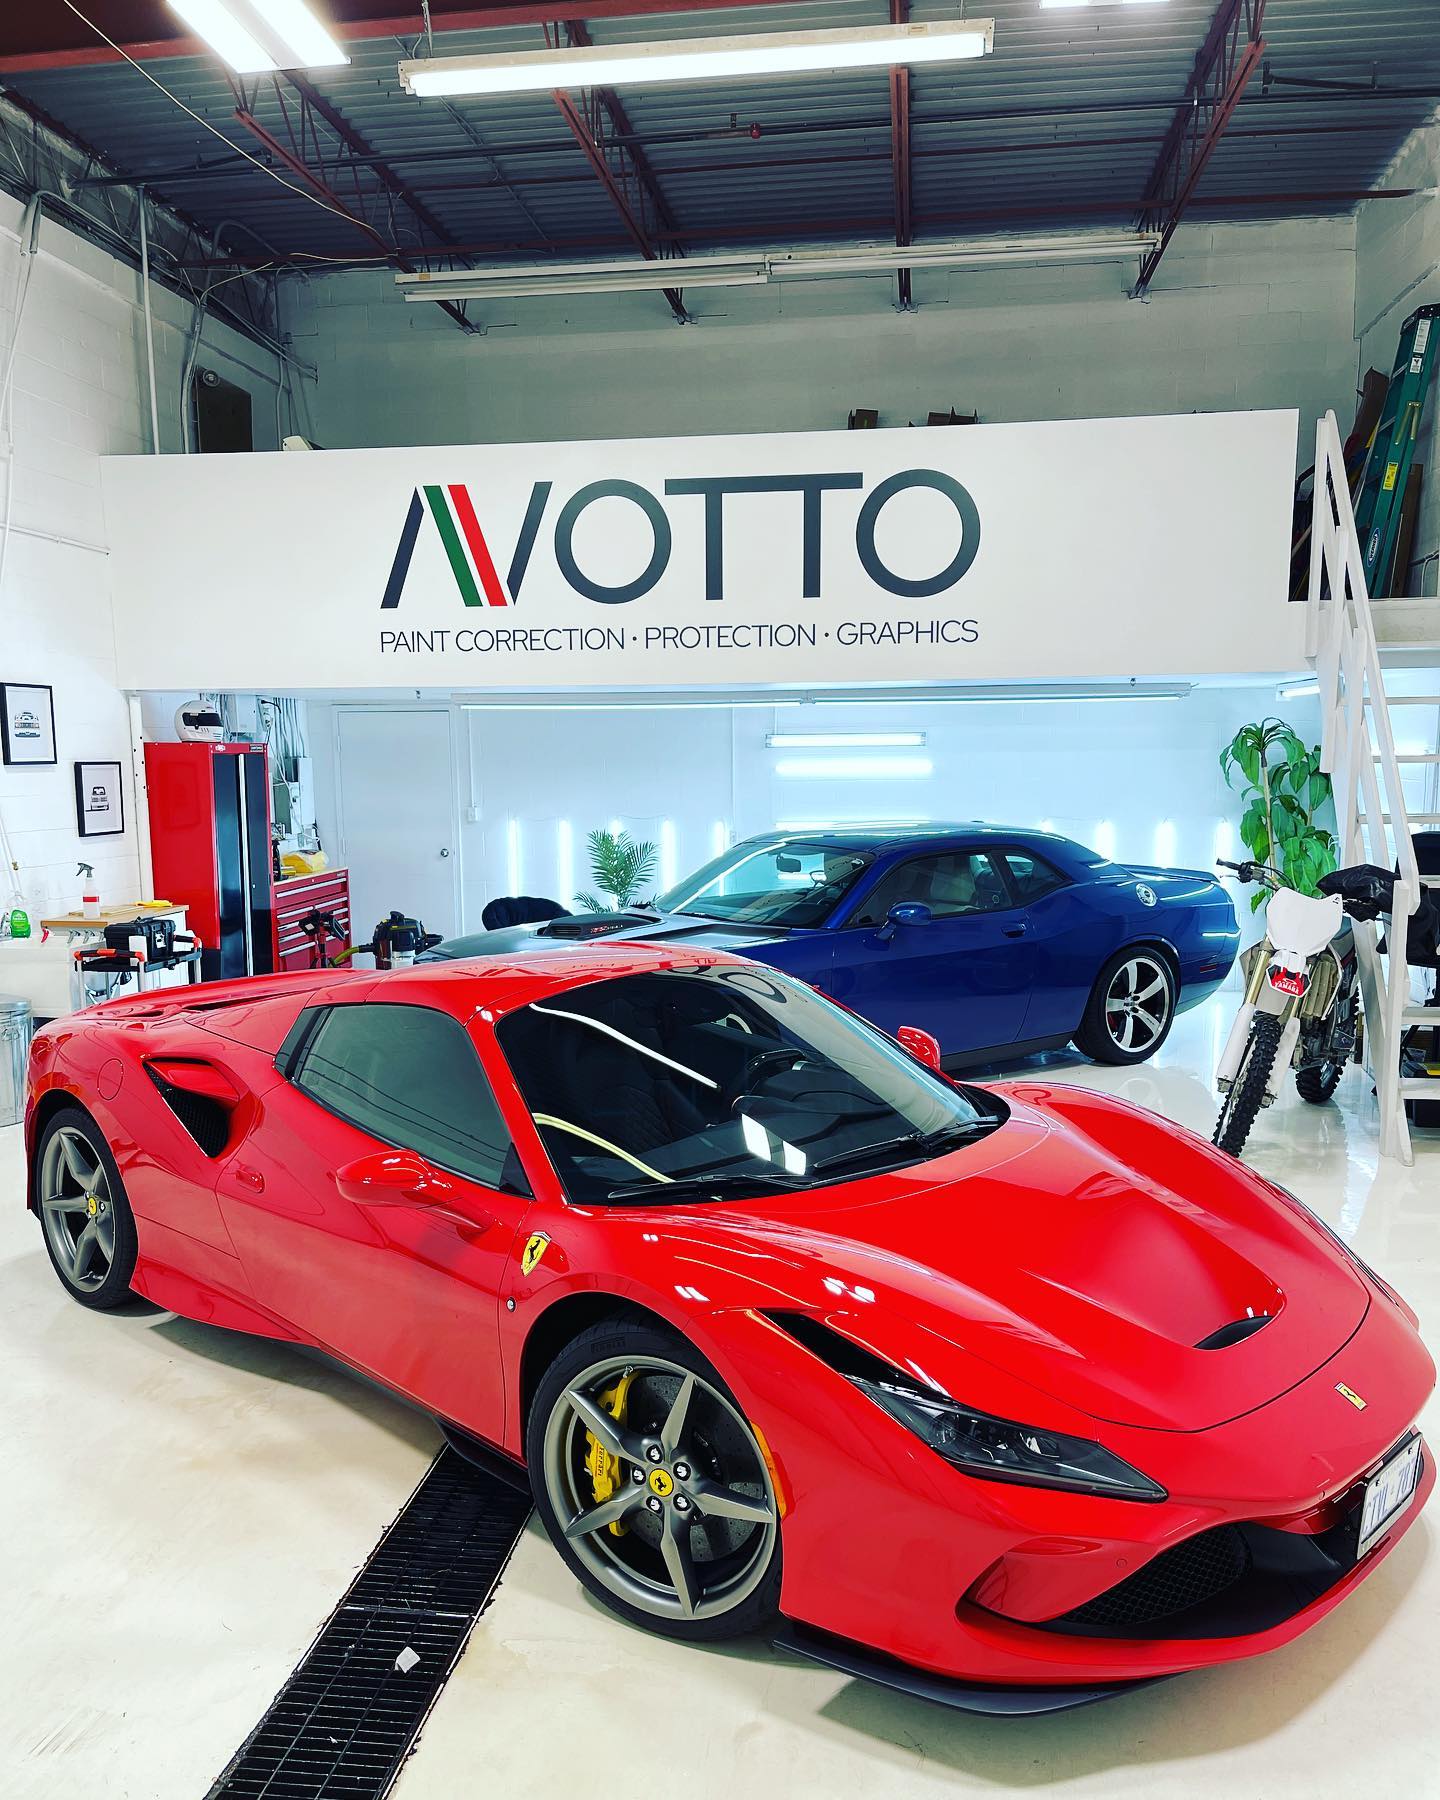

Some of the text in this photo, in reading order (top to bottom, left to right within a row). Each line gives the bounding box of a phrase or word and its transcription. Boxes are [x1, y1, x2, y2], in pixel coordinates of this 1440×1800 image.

[380, 468, 981, 609] AVOTTO
[380, 619, 979, 653] PAINT CORRECTION PROTECTION GRAPHICS
[1274, 980, 1299, 994] YAMAHA
